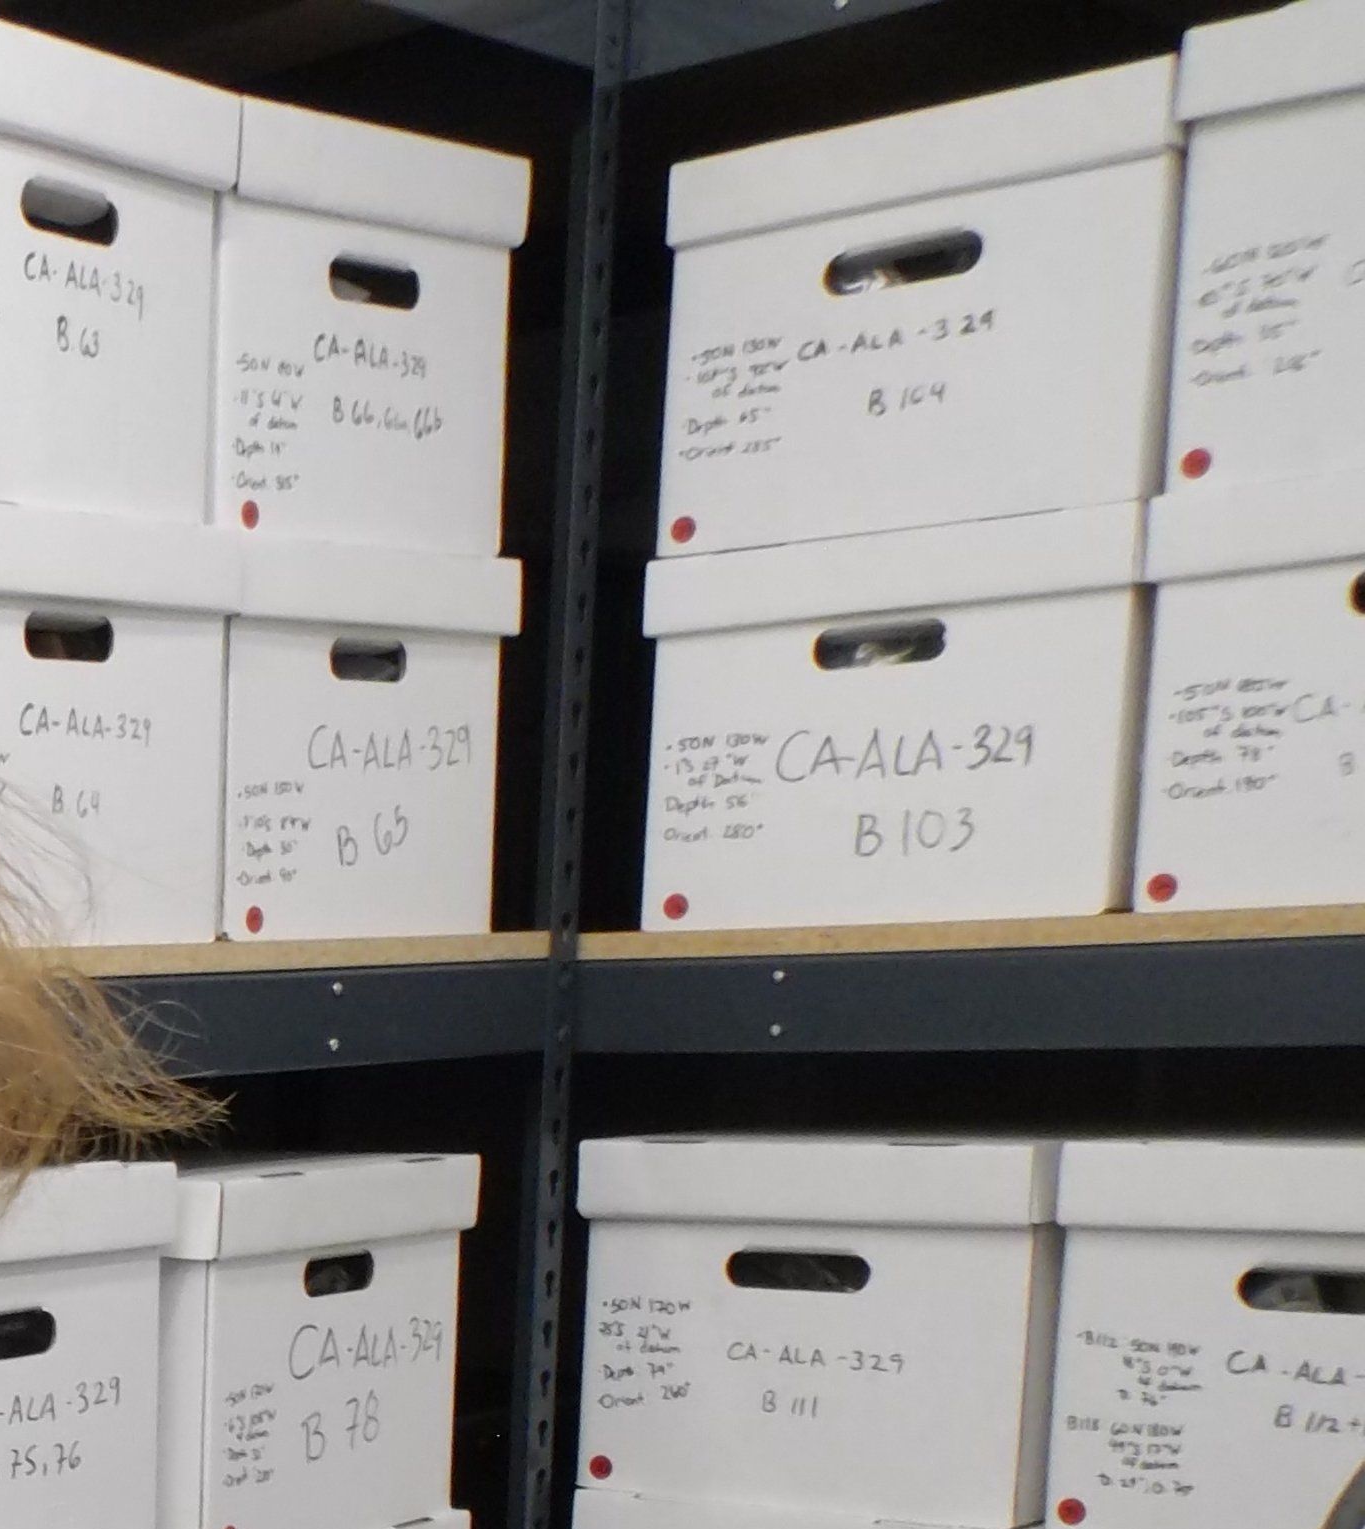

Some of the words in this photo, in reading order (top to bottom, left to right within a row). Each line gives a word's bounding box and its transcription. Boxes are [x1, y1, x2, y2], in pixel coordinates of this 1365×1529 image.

[796, 308, 996, 362] CA-ALA-329
[19, 702, 152, 747] CA-ALA-329
[308, 724, 471, 771] CA-ALA-329
[775, 724, 1035, 783] CA-ALA-329
[337, 825, 358, 866] B
[374, 805, 408, 855] 65
[289, 1316, 443, 1380] CA-ALA-329
[726, 1341, 906, 1374] CA-ALA-329
[302, 1412, 325, 1463] B
